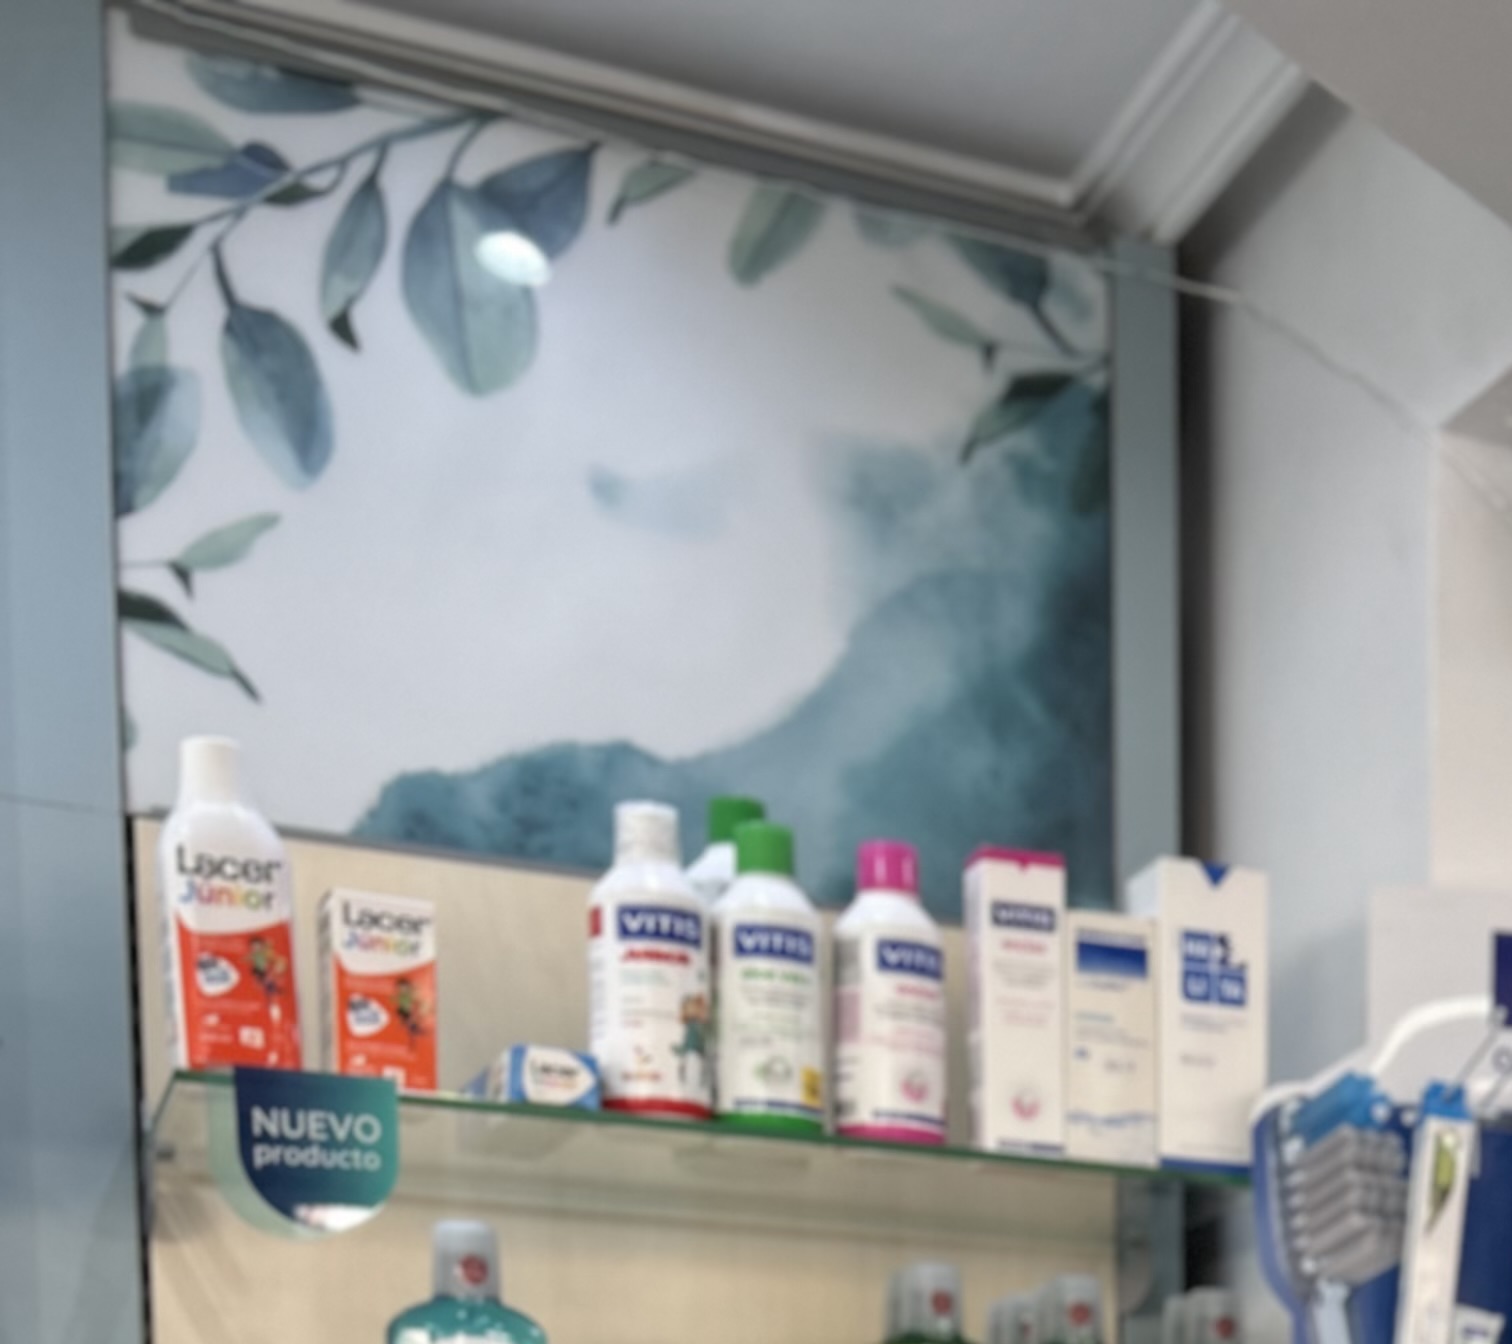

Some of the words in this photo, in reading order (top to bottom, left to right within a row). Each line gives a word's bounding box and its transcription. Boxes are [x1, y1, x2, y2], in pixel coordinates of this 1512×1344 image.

[177, 845, 281, 884] Lacer
[342, 901, 432, 936] Lacer
[621, 910, 701, 943] VITIS
[735, 930, 814, 962] VITIS
[251, 1107, 382, 1144] NUEVO
[253, 1141, 381, 1171] producto
